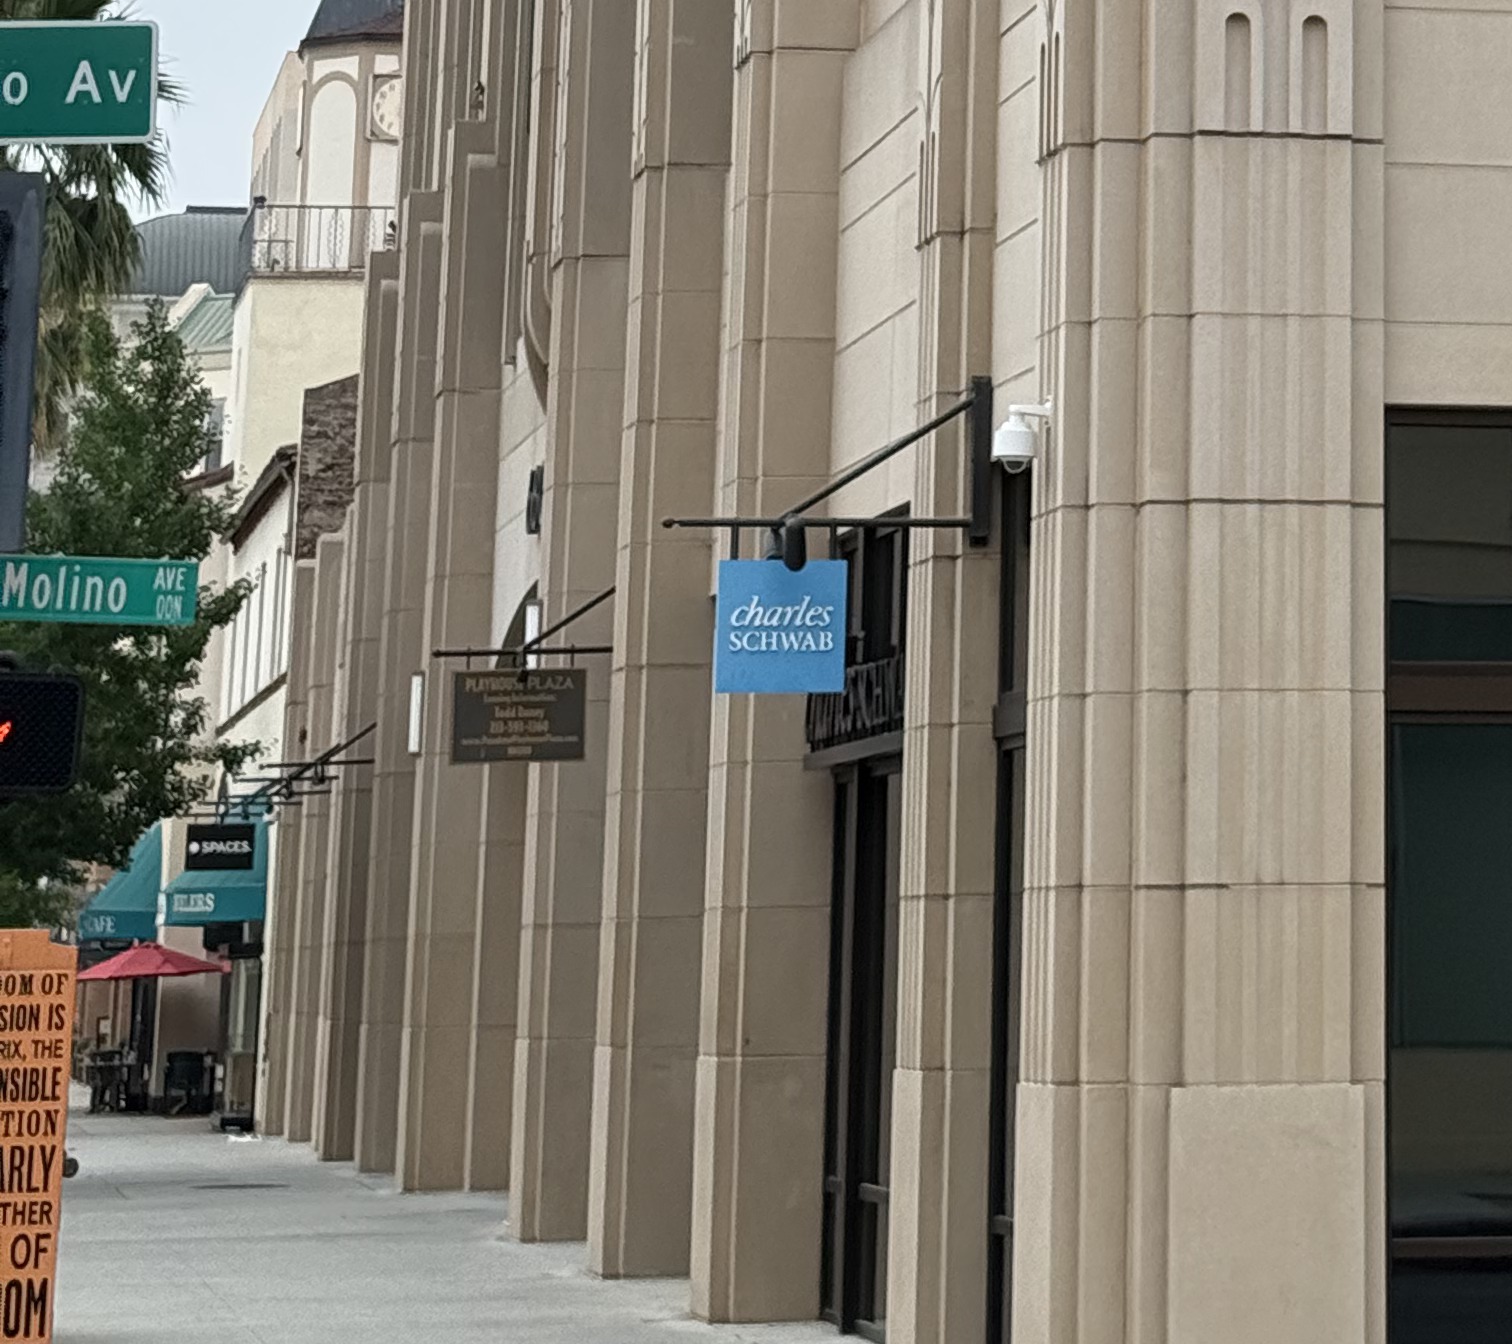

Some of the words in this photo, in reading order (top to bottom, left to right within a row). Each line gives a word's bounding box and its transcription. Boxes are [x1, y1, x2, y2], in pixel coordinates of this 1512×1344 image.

[65, 59, 137, 103] Av
[2, 562, 127, 612] Molino
[153, 567, 188, 591] AVE
[730, 595, 834, 627] charles
[729, 631, 834, 651] SCHWAB
[527, 676, 574, 690] PLAZA
[0, 974, 33, 996] OM
[41, 973, 69, 995] OF
[48, 1003, 66, 1031] IS
[32, 1039, 64, 1059] THE
[0, 1201, 52, 1226] THER
[11, 1233, 51, 1269] OF
[0, 1278, 48, 1338] OM
